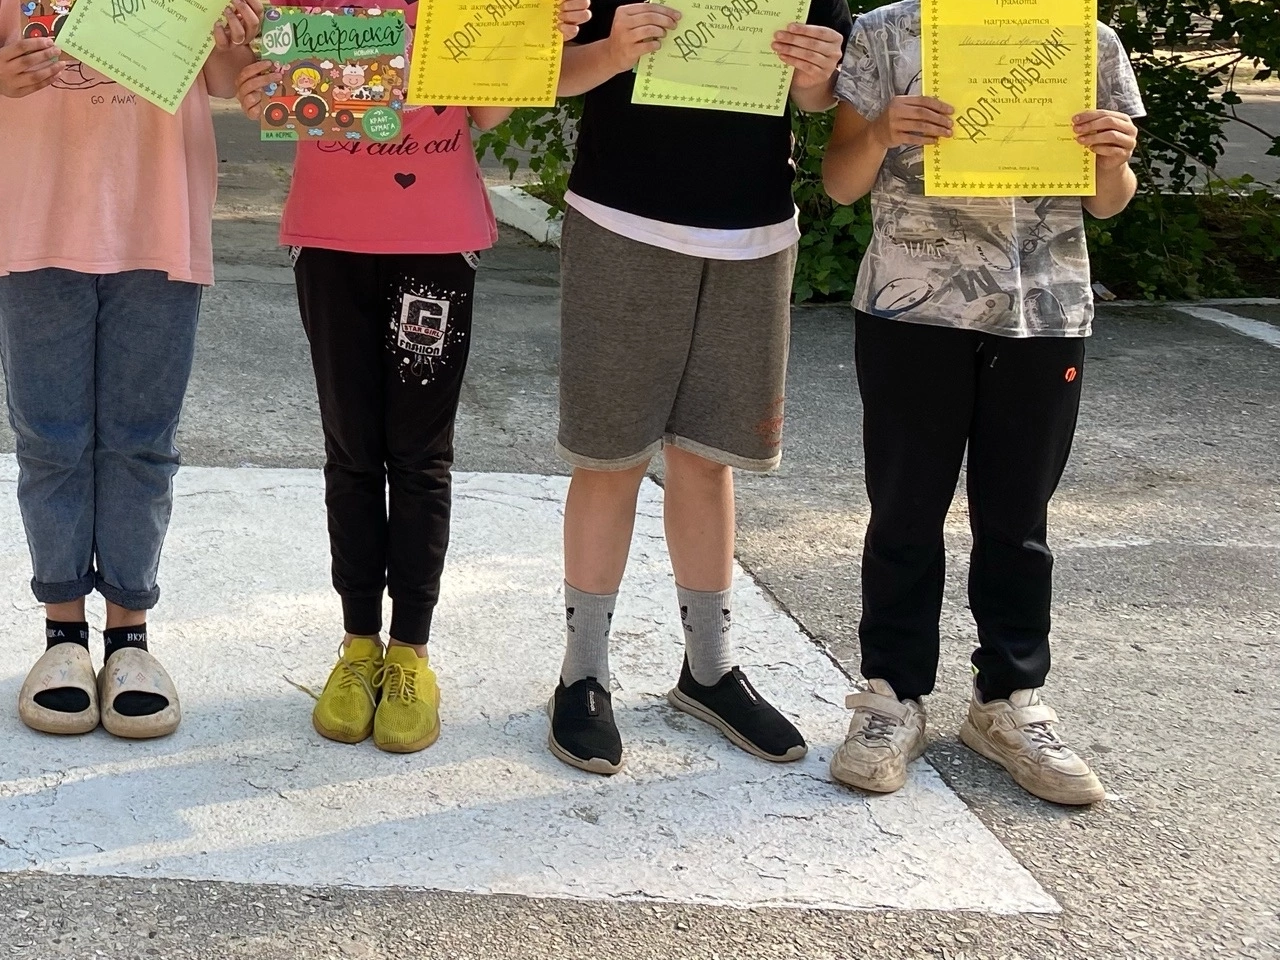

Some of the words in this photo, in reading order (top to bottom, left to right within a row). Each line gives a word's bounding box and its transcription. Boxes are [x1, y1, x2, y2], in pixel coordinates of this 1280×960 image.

[167, 6, 188, 23] лагеря
[983, 17, 1050, 28] награждается
[737, 25, 764, 34] лагеря
[265, 28, 291, 48] ЭКО
[292, 18, 405, 62] Раскраска
[353, 48, 380, 56] НОВИНКА
[91, 94, 105, 105] GO
[990, 97, 1020, 105] жизни
[1022, 97, 1053, 107] лагеря
[369, 116, 392, 124] КРАФТ-
[371, 123, 395, 132] БУМАГА
[366, 134, 421, 156] cute
[424, 129, 464, 154] cat
[404, 324, 422, 333] STAR
[424, 327, 440, 337] GIRL
